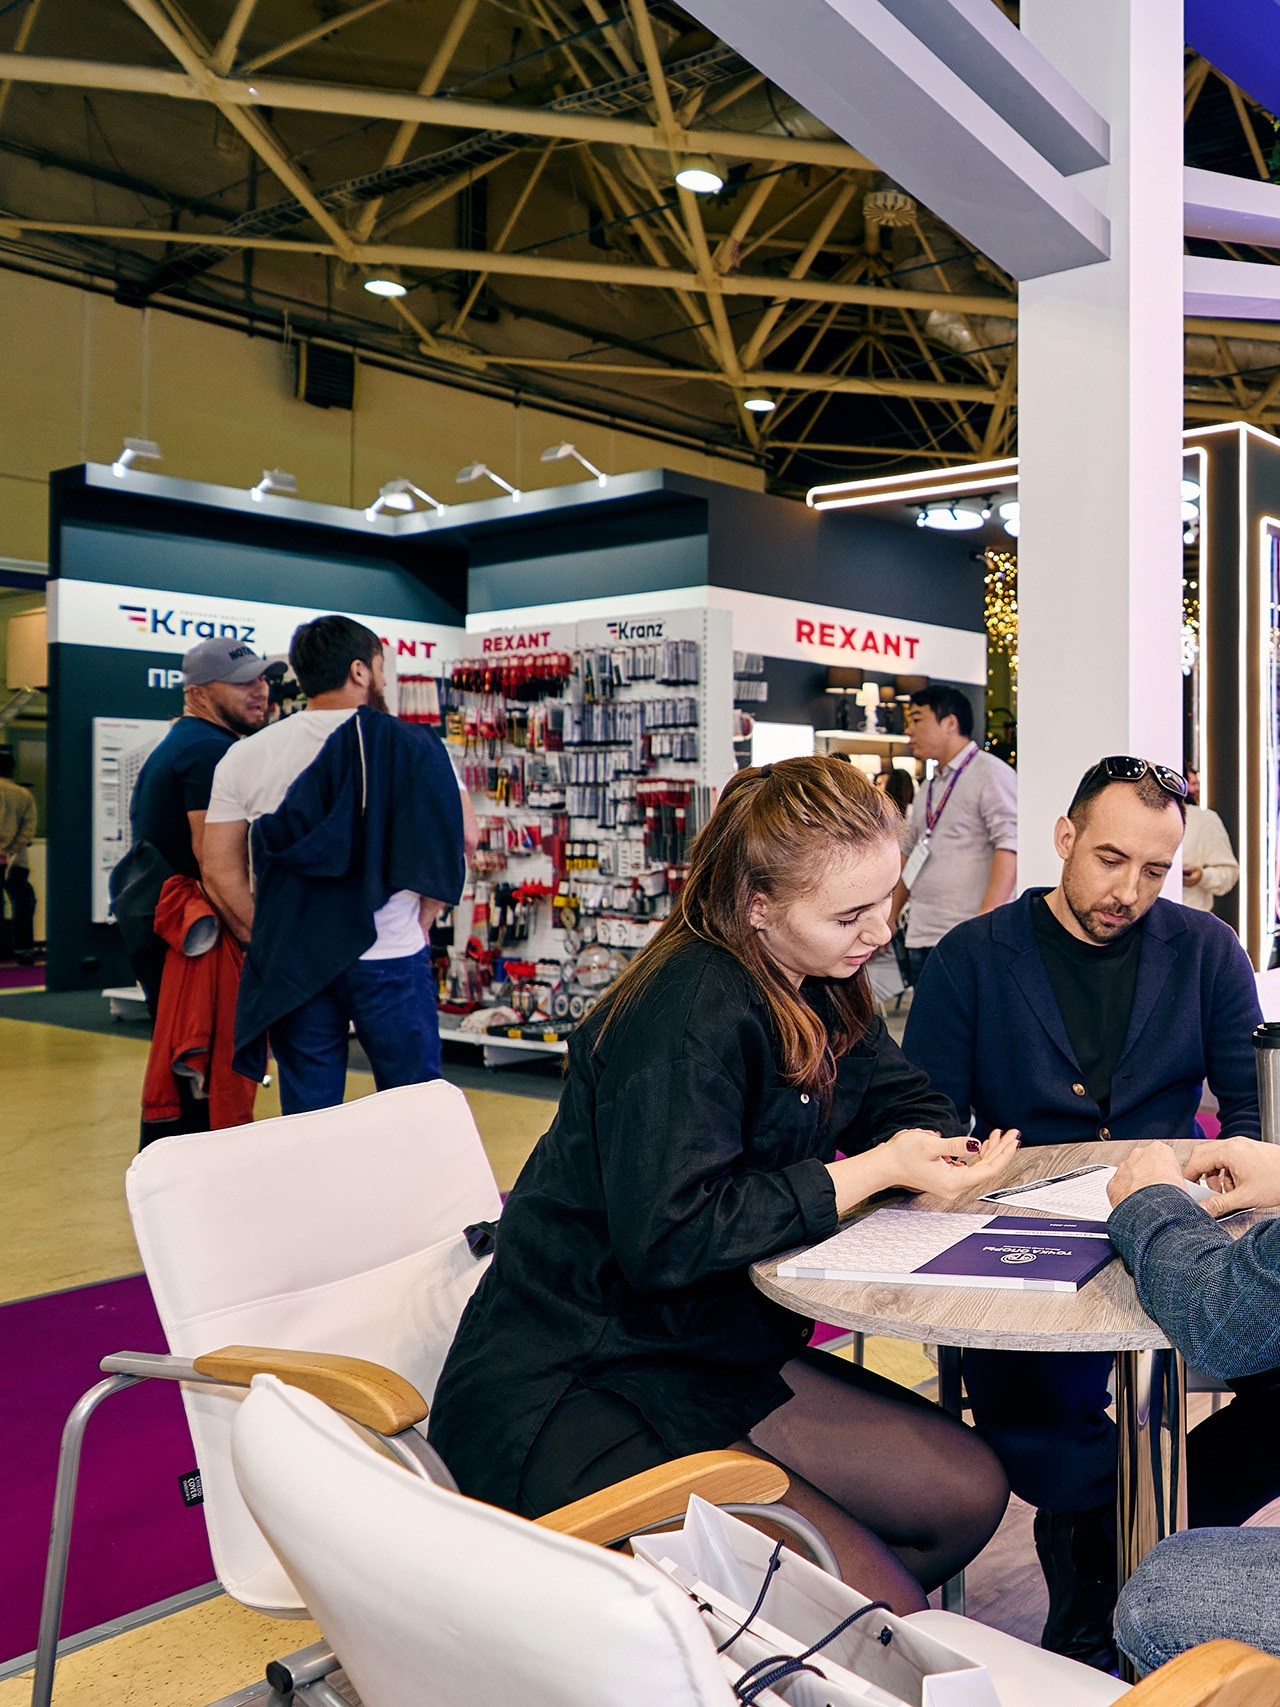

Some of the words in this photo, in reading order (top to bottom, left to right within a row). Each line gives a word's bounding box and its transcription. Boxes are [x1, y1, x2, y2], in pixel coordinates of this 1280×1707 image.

[151, 608, 256, 643] Kranz
[618, 621, 663, 640] Kranz
[381, 637, 437, 659] NT
[482, 631, 551, 653] REXANT
[795, 618, 921, 660] REXANT
